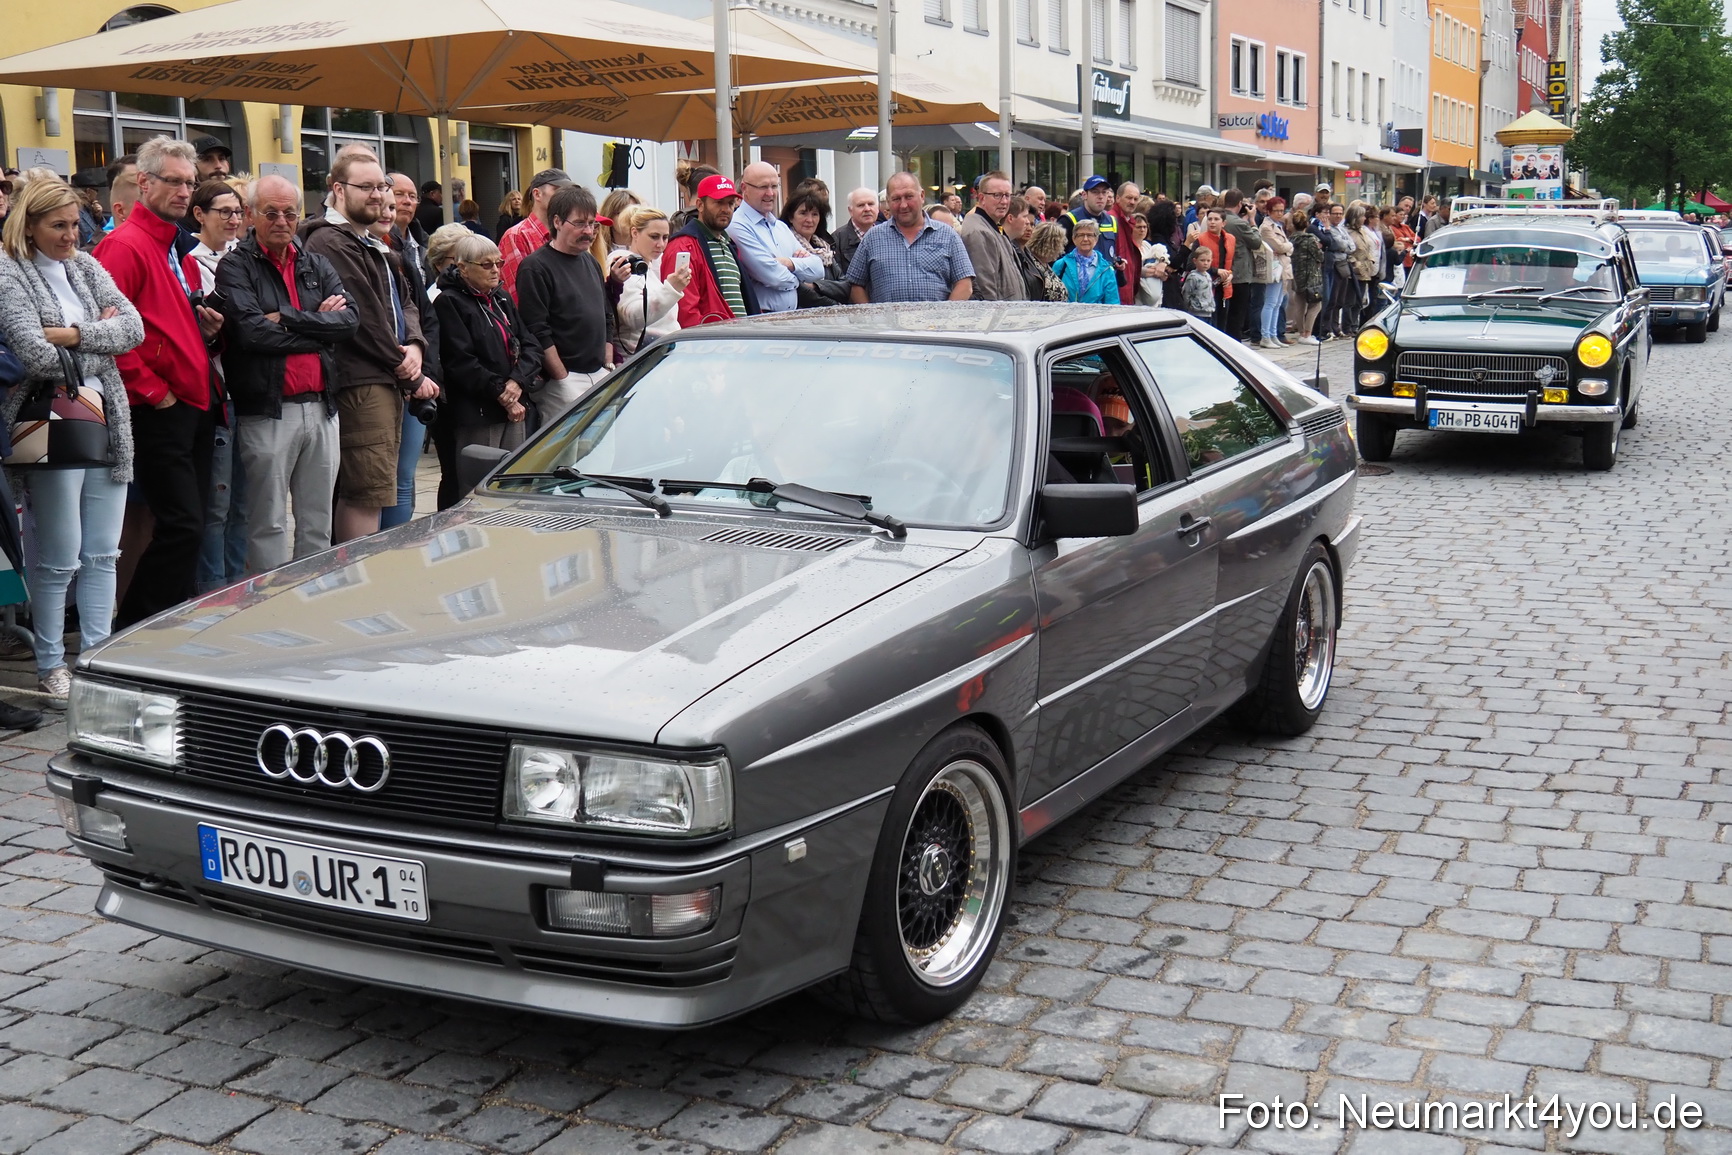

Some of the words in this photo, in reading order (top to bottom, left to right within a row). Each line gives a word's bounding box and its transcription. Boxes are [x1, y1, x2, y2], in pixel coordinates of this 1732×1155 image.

[184, 19, 348, 40] Neumarkter
[118, 26, 350, 56] Lammsbräu
[536, 147, 548, 161] 24
[761, 344, 995, 367] quattro
[1437, 412, 1455, 426] RH
[1464, 413, 1481, 428] PB
[208, 858, 216, 871] D
[220, 836, 289, 890] ROD
[312, 854, 364, 904] UR
[372, 865, 398, 910] 1
[400, 868, 416, 883] 04
[403, 899, 419, 913] 10
